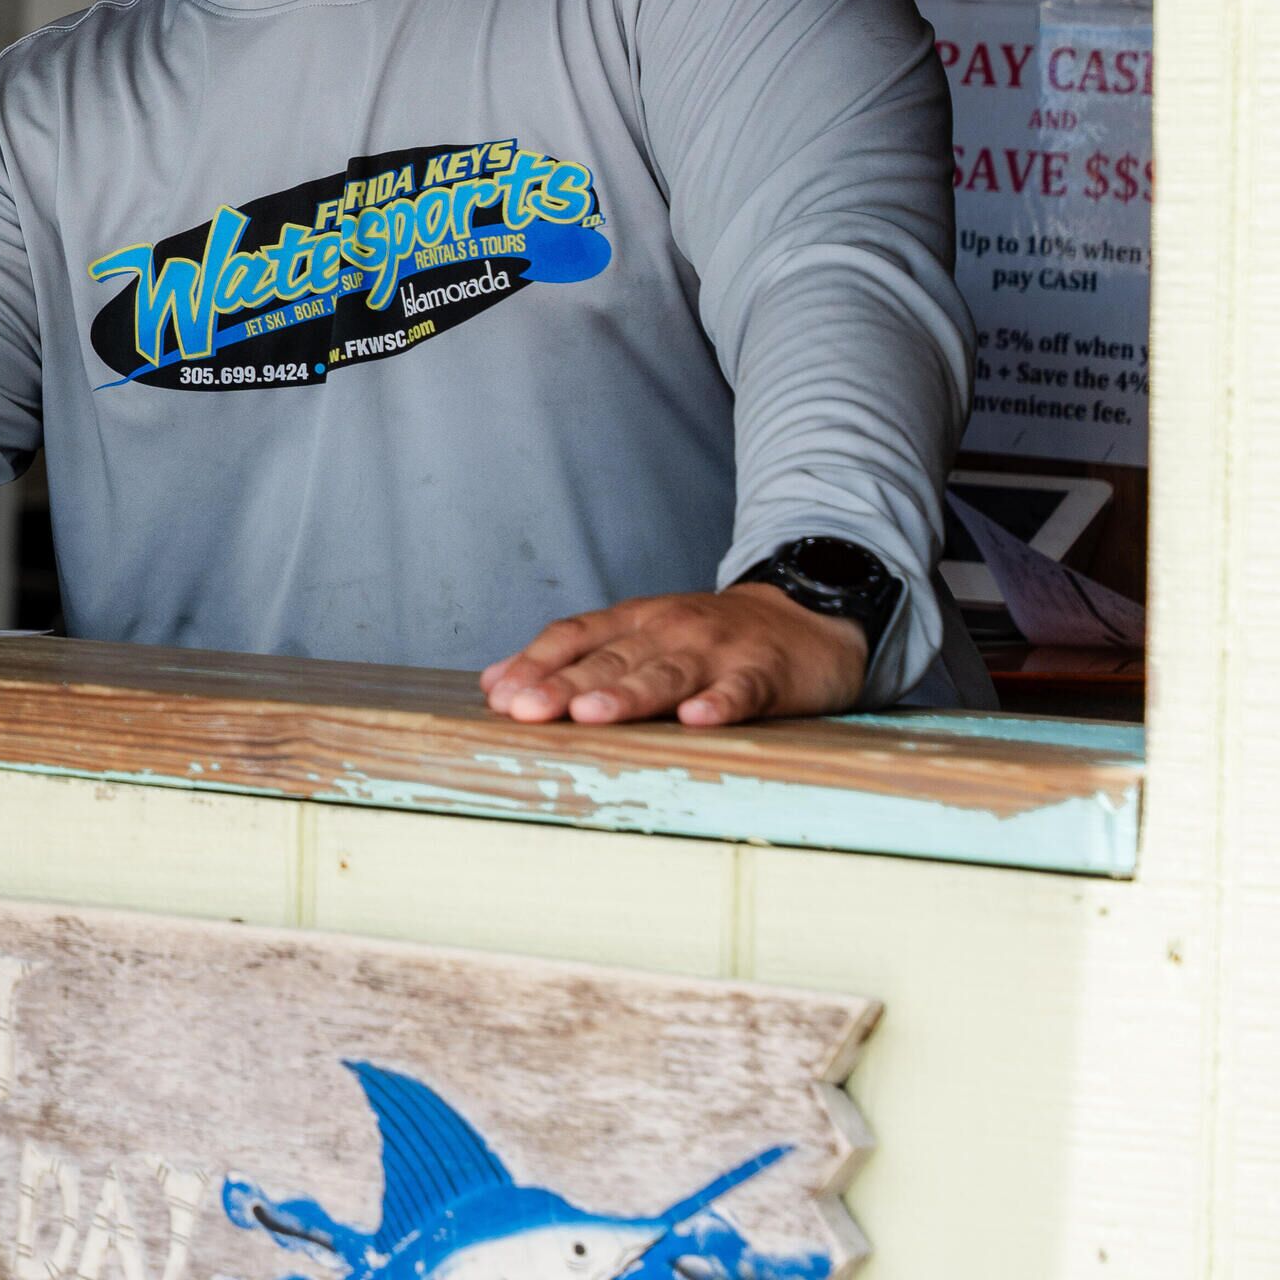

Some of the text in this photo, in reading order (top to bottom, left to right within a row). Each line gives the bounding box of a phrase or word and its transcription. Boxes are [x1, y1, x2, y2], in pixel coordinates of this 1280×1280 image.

[935, 40, 1035, 89] PAY
[1028, 108, 1077, 132] AND
[423, 138, 517, 188] KEYS
[88, 150, 593, 367] Watesports
[414, 233, 526, 270] RENTALS & TOURS
[960, 229, 990, 258] Up
[997, 235, 1019, 255] to
[1028, 235, 1076, 261] 10%
[1083, 240, 1141, 264] when
[400, 260, 510, 318] Islamorada
[992, 268, 1098, 293] pay CASH
[244, 320, 264, 337] JET
[266, 311, 287, 331] SKI
[293, 300, 325, 320] BOAT
[341, 272, 364, 291] SUP
[180, 319, 436, 384] 305.699.9424 w.FKWSC.com
[995, 327, 1034, 354] 5%
[1039, 332, 1071, 355] off
[1074, 335, 1135, 361] when
[1016, 361, 1068, 388] Save
[1073, 366, 1110, 391] the
[974, 394, 1132, 425] nvenience fee.
